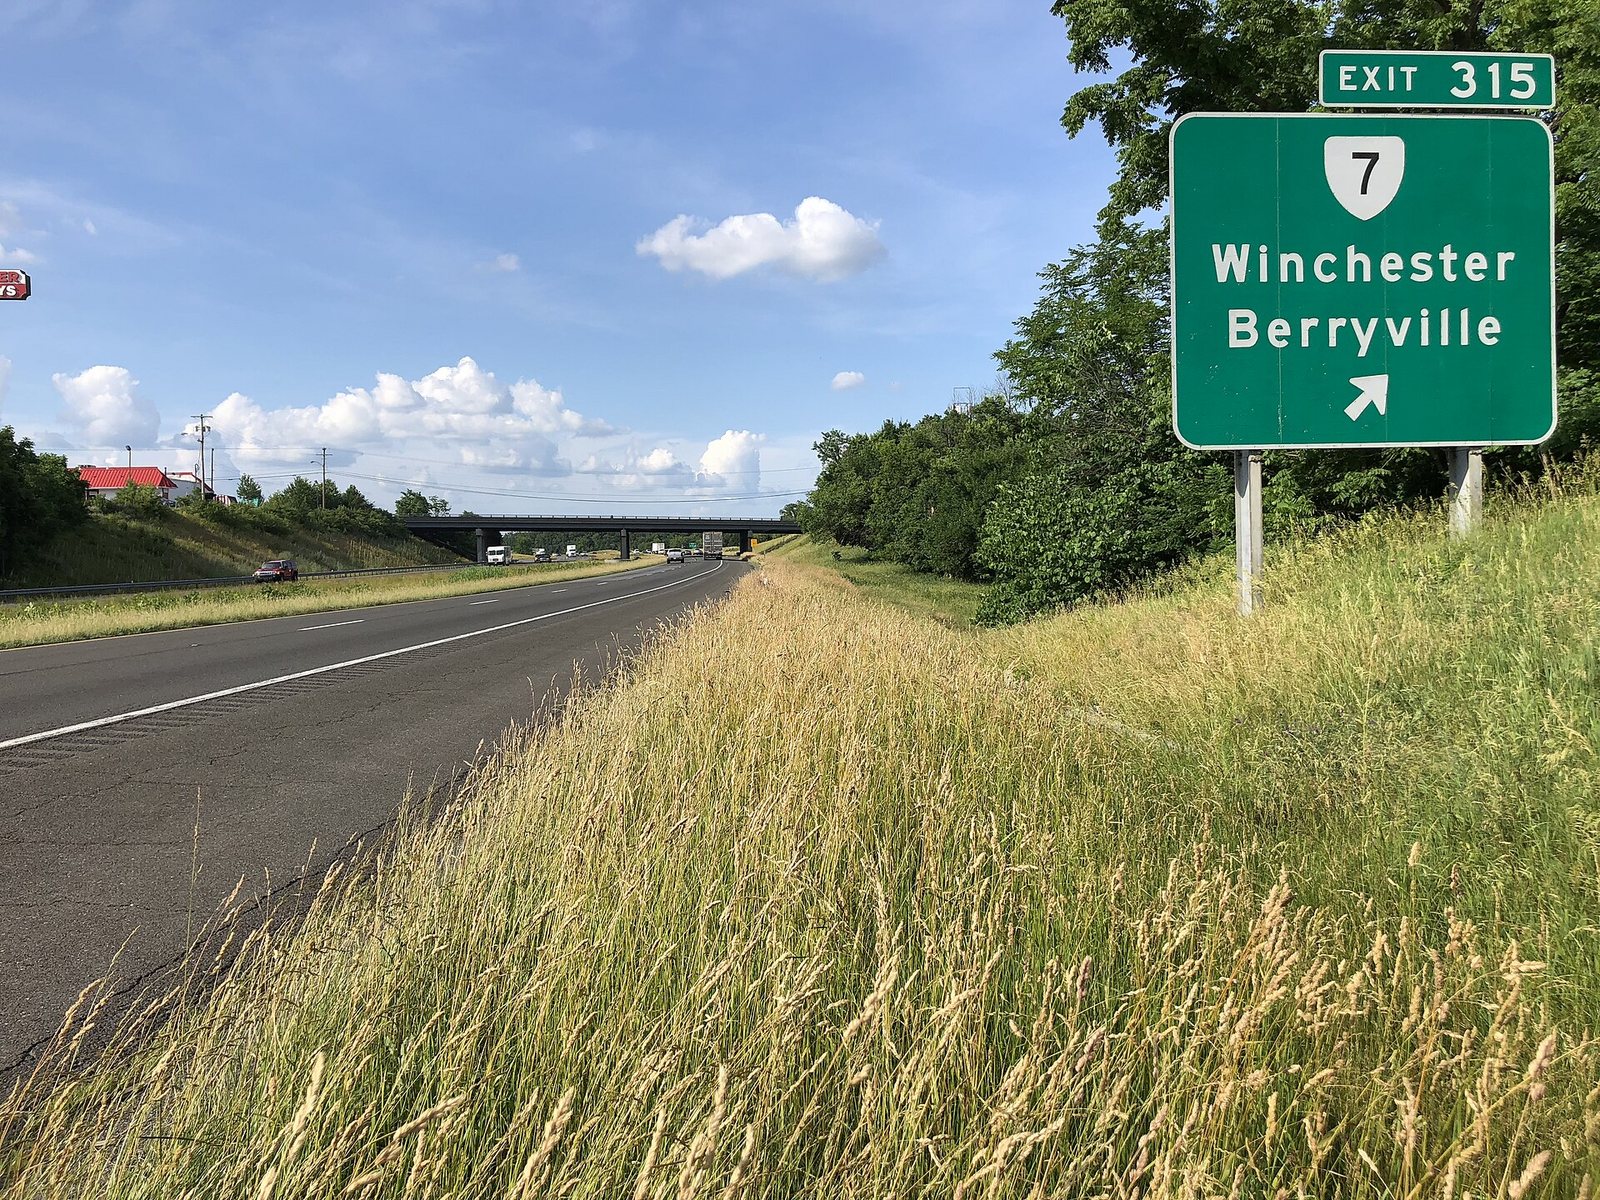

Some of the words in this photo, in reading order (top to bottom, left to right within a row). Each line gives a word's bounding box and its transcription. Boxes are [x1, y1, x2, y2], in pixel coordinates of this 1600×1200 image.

[1339, 66, 1418, 92] EXIT
[1450, 61, 1537, 99] 315
[1351, 152, 1380, 195] 7
[1211, 243, 1516, 283] Winchester
[1228, 308, 1502, 357] Berryville
